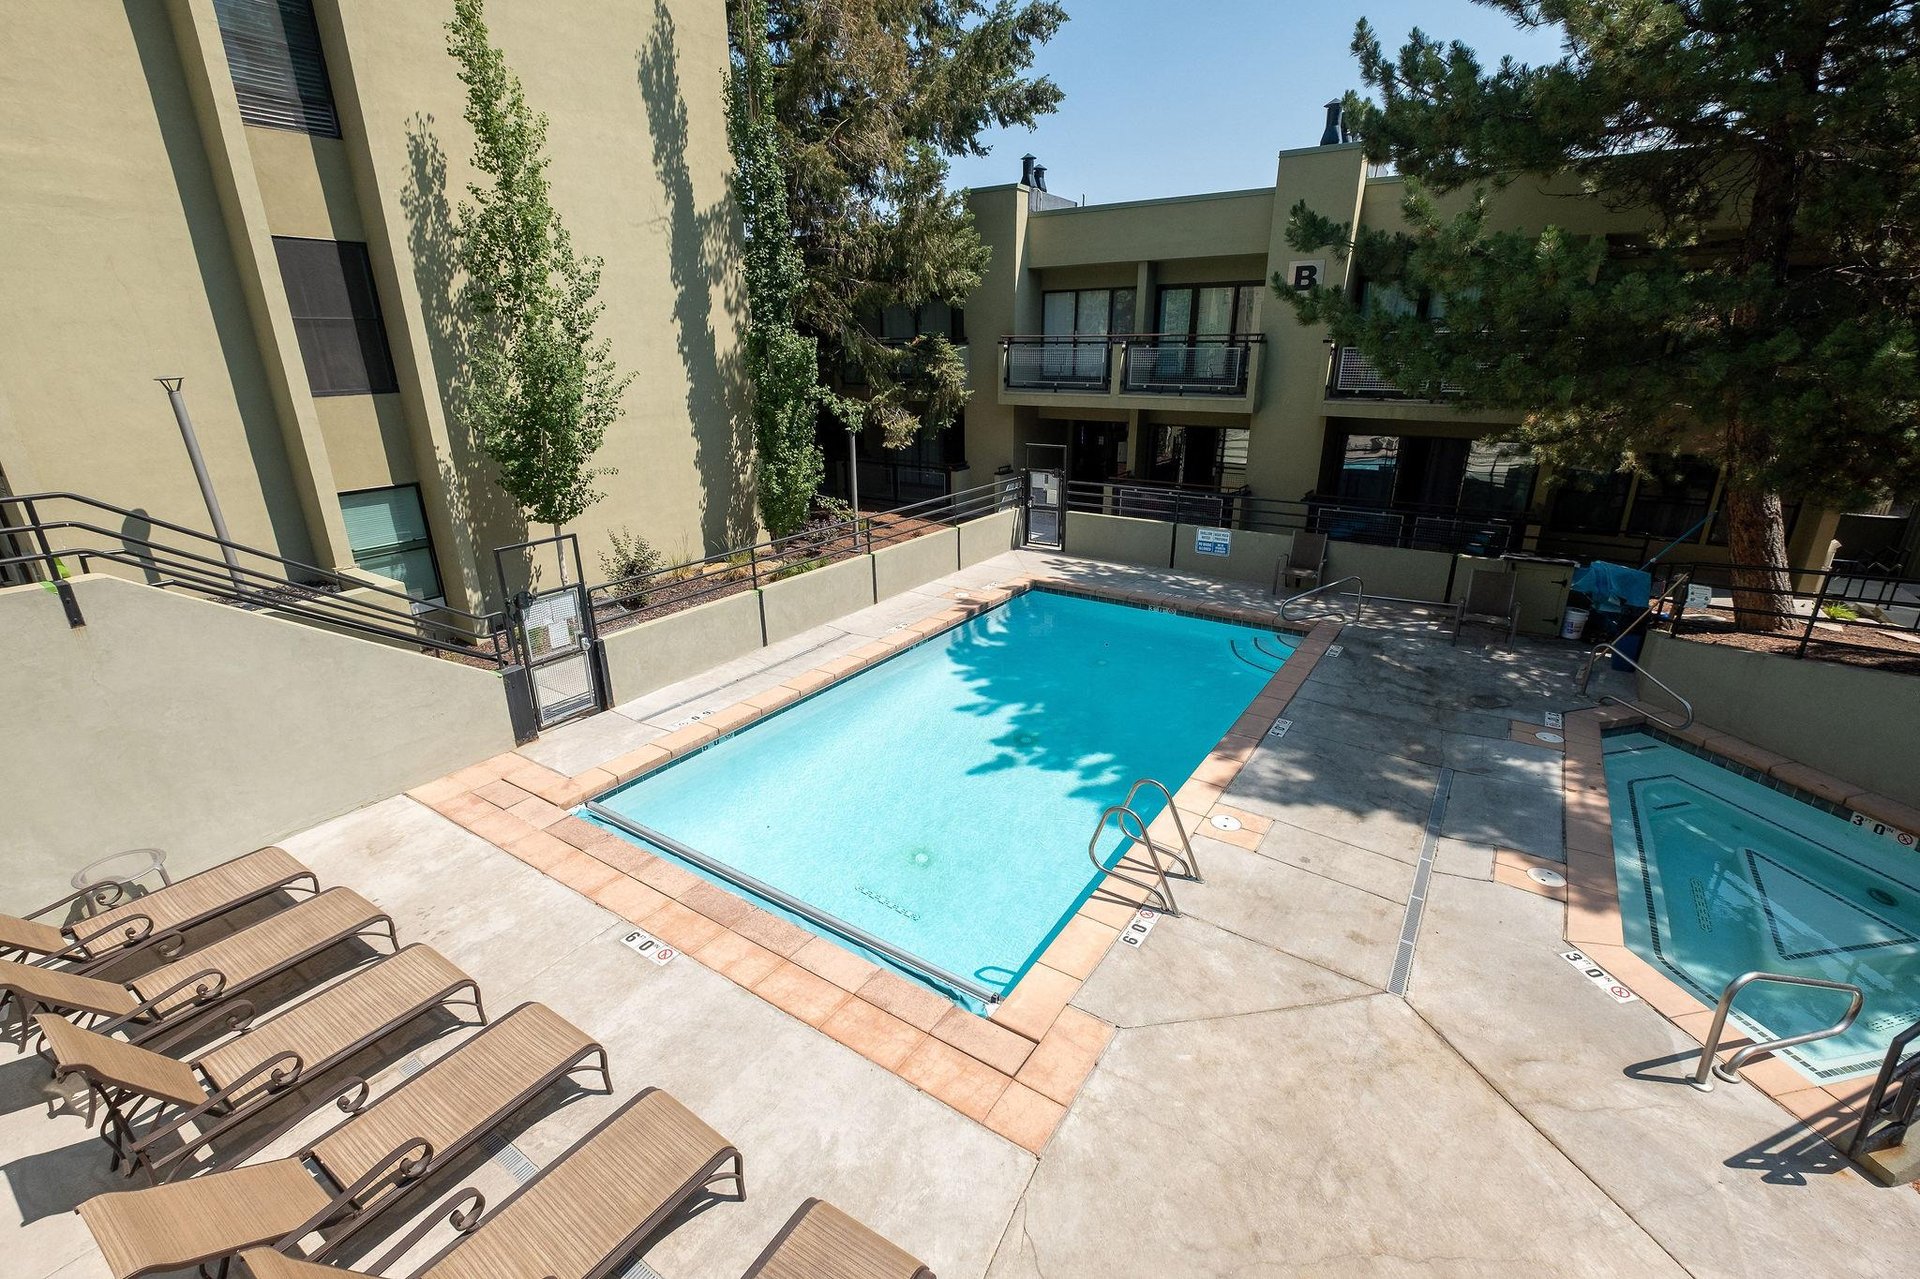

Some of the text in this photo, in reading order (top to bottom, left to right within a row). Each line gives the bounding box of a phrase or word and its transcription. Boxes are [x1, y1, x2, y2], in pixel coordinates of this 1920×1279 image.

[1294, 265, 1317, 291] B
[1852, 814, 1864, 826] 3
[1873, 823, 1886, 836] 0
[625, 931, 641, 942] 6
[638, 940, 655, 951] 0
[1122, 935, 1138, 945] 6
[1131, 923, 1147, 933] 0
[1565, 952, 1583, 961] 3
[1585, 968, 1604, 978] 0
